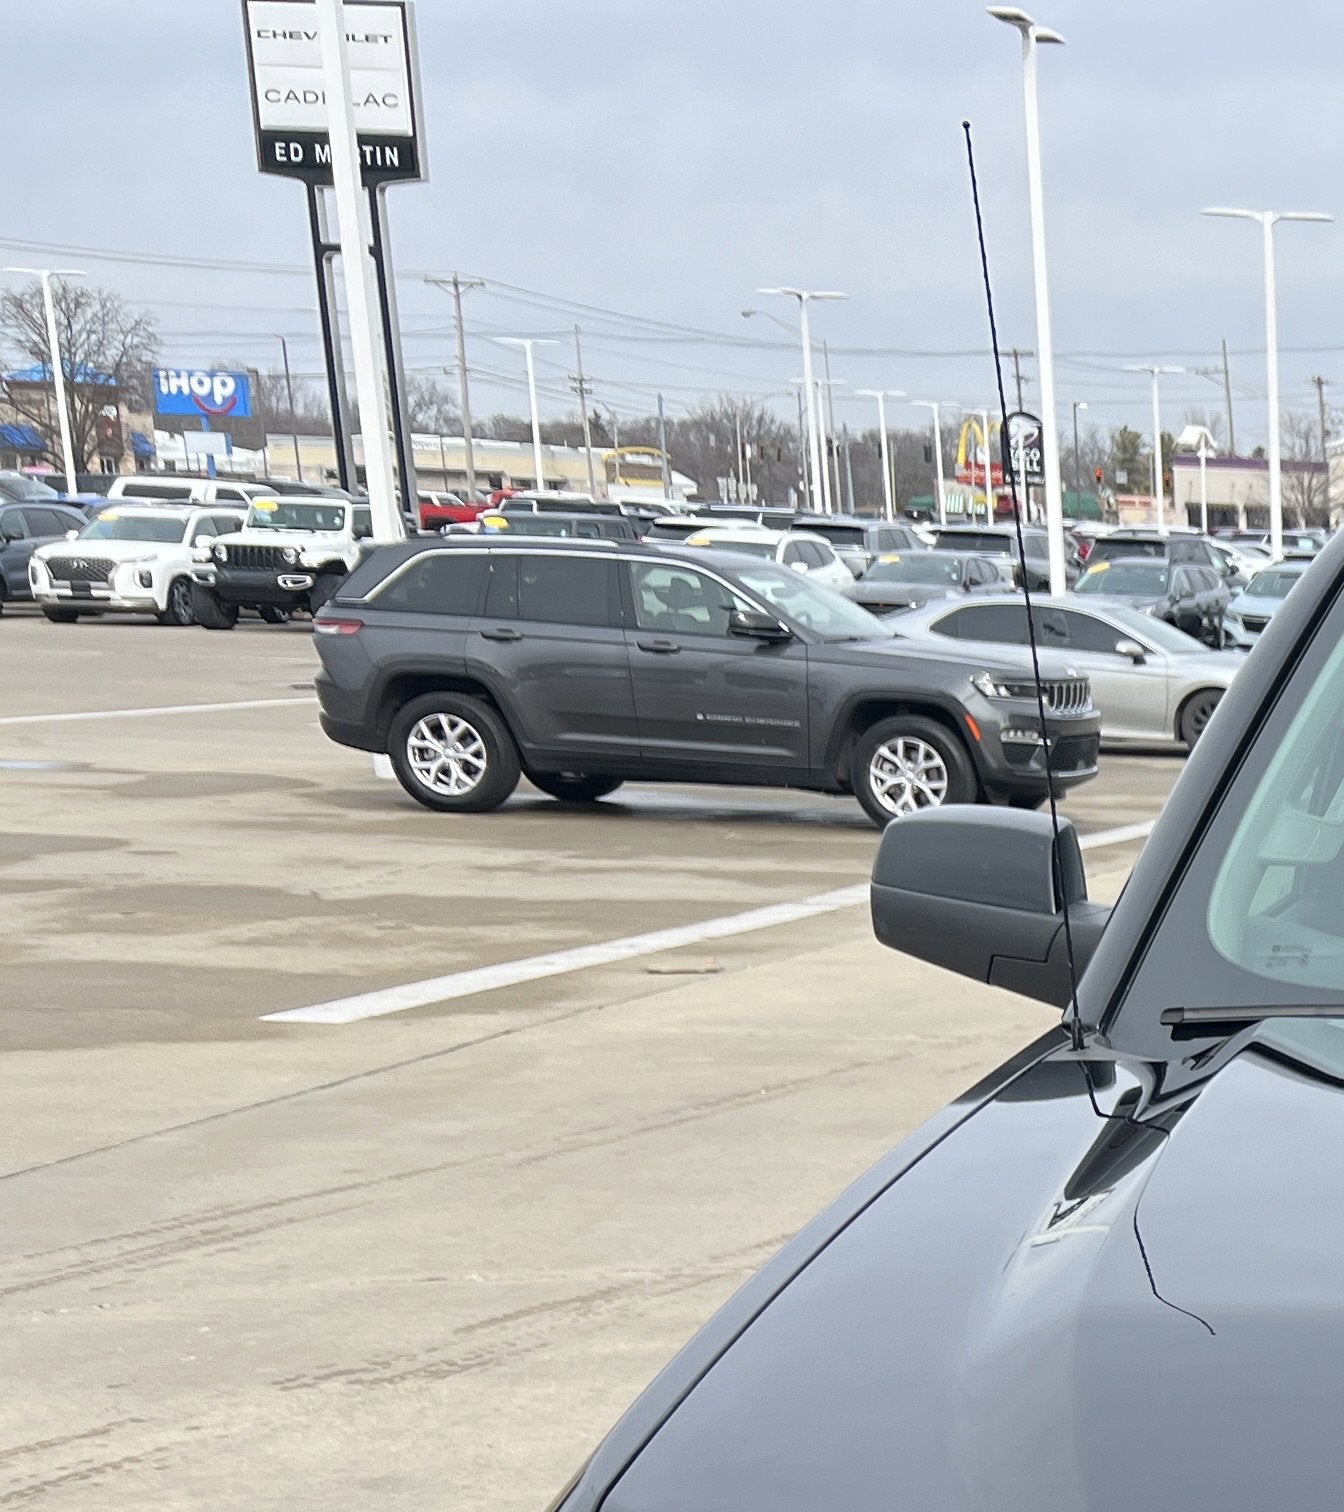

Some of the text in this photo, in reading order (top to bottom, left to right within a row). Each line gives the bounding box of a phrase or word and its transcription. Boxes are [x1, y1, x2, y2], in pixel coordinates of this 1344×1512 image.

[257, 29, 392, 44] CHEVLET
[275, 142, 400, 168] ED MTIN
